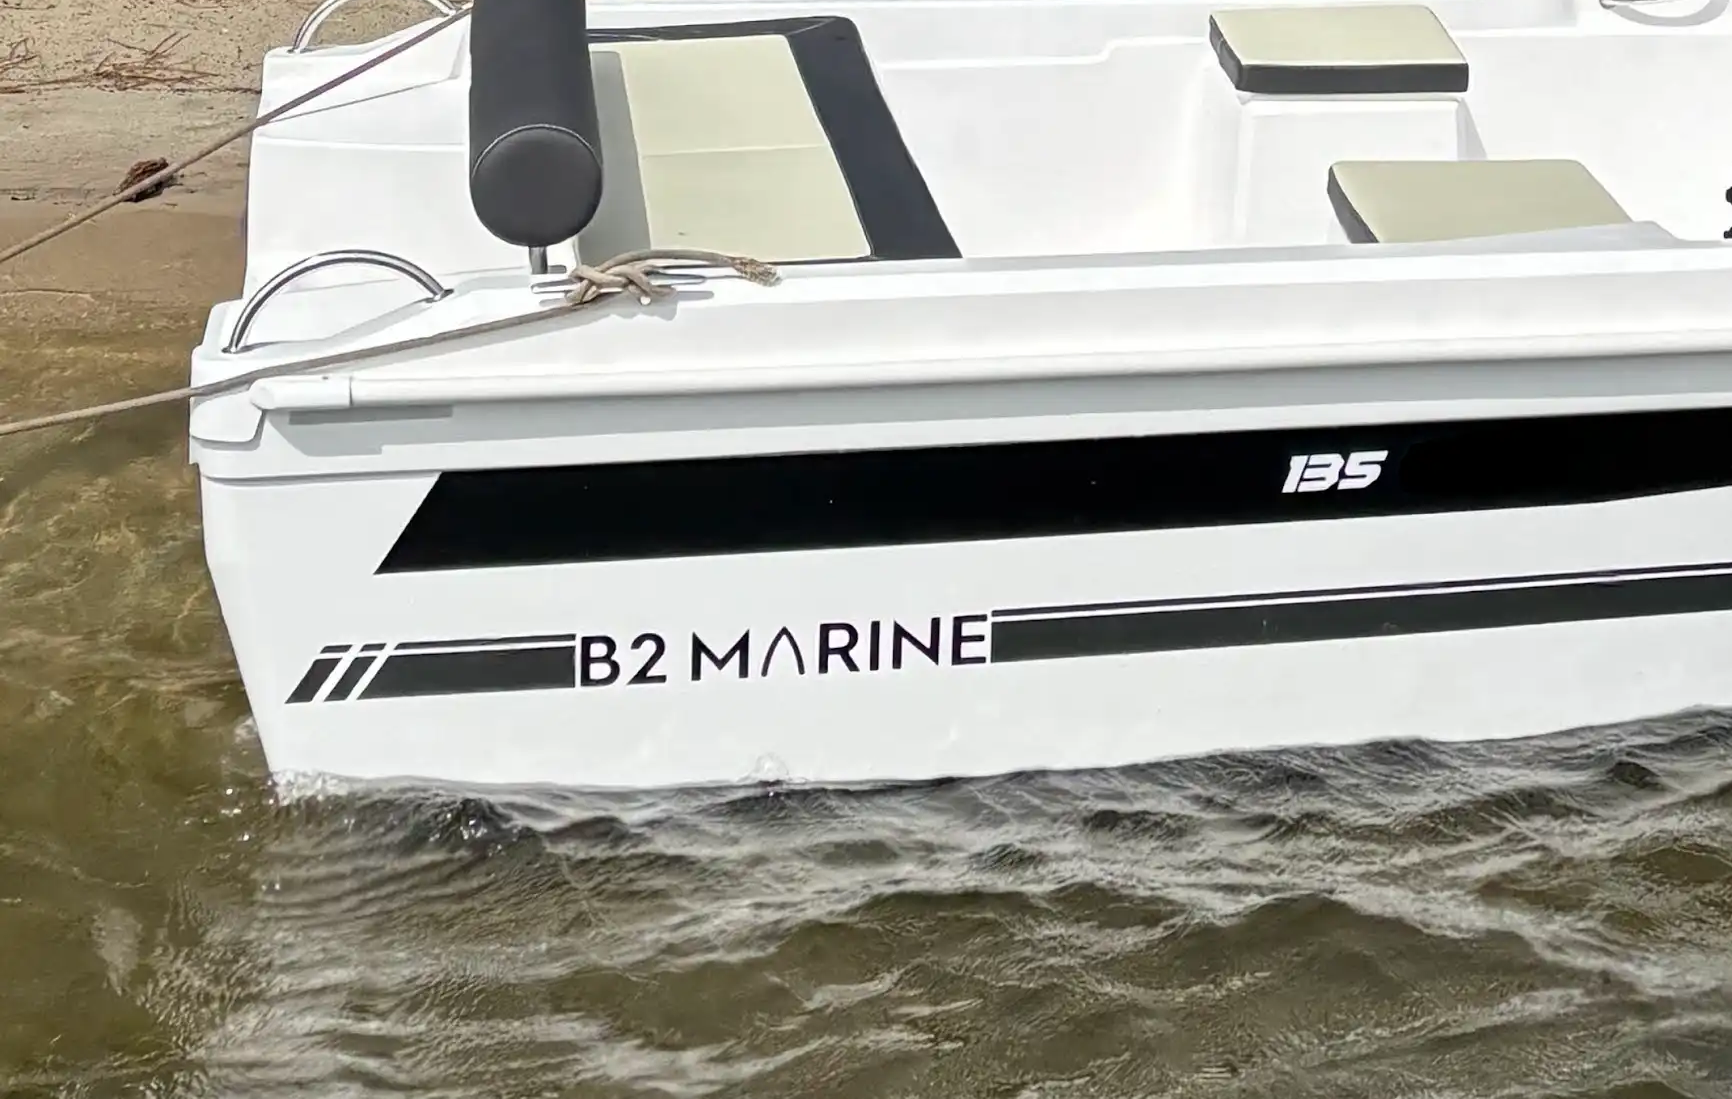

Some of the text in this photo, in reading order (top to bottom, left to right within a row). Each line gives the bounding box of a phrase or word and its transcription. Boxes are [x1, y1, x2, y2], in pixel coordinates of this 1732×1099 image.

[1281, 449, 1389, 494] 135
[579, 613, 988, 688] B2 MARINE
